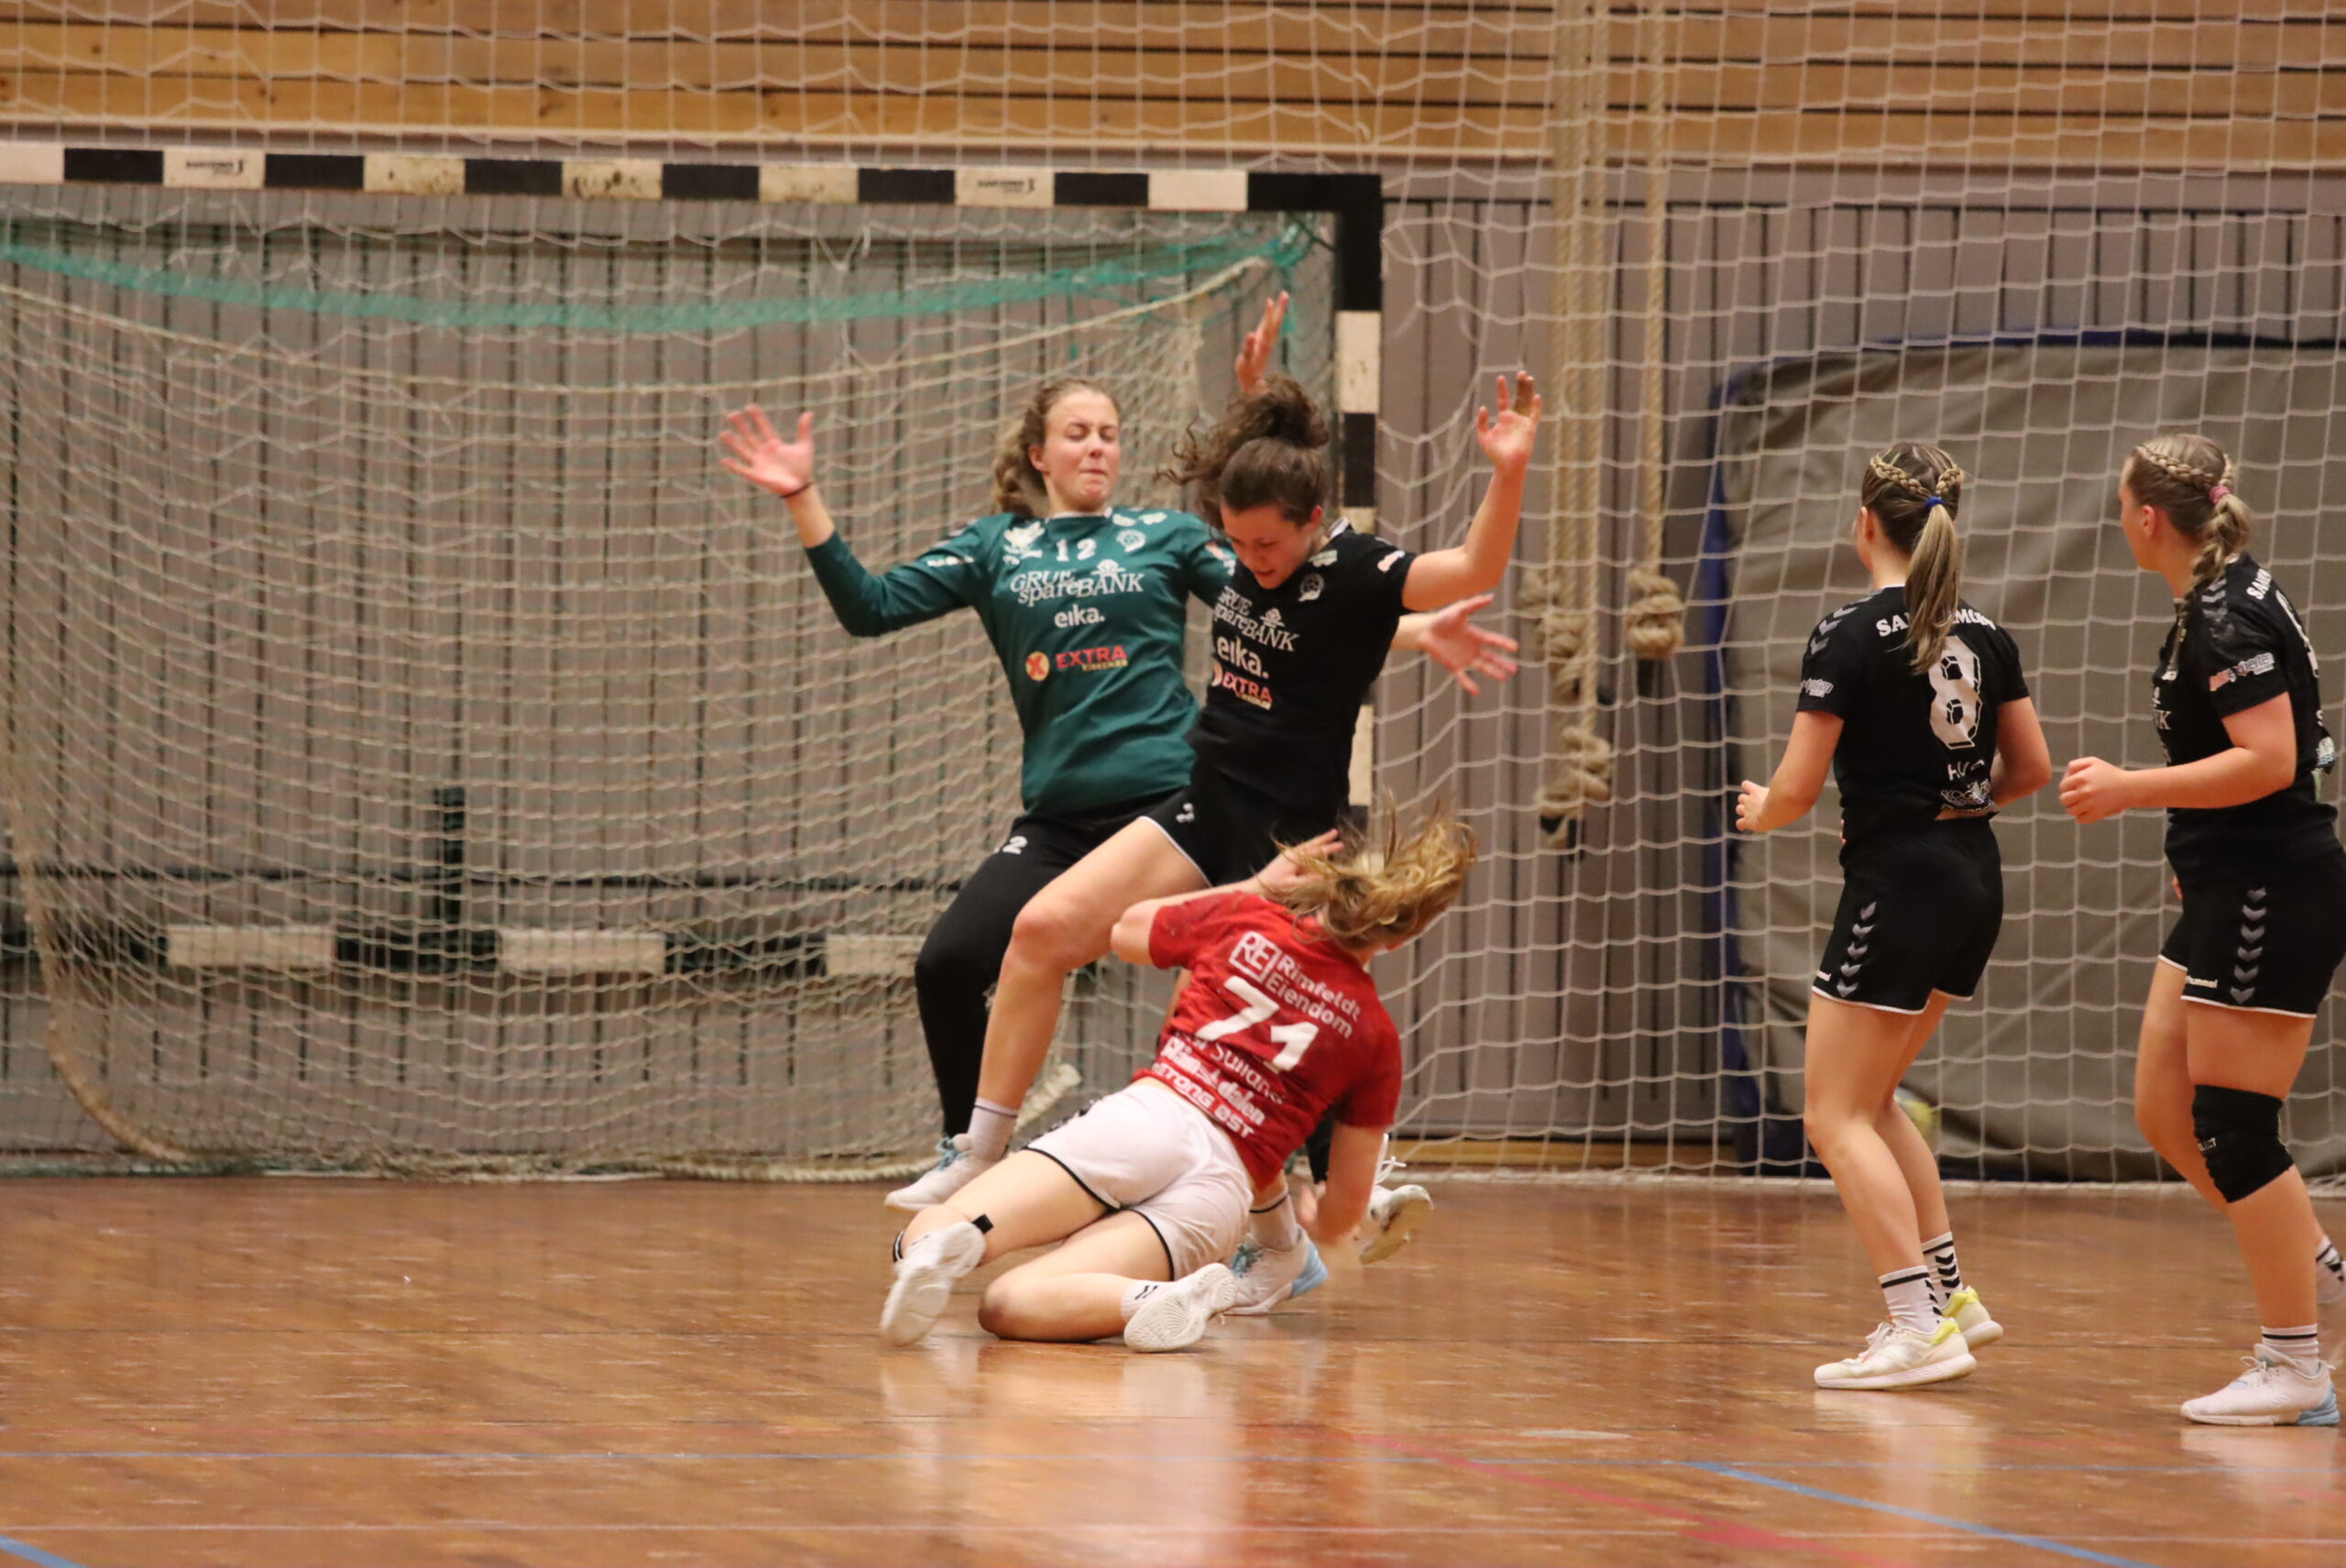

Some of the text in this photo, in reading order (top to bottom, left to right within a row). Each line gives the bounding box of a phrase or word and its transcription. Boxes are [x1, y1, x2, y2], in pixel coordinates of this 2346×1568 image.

[1056, 538, 1097, 562] 12
[1056, 645, 1128, 669] EXTRA
[1222, 671, 1274, 703] EXTRA
[1928, 634, 1983, 750] 8
[1265, 971, 1354, 1039] Eiendom
[1277, 954, 1362, 1023] Rimfeldt
[1194, 975, 1320, 1071] 71
